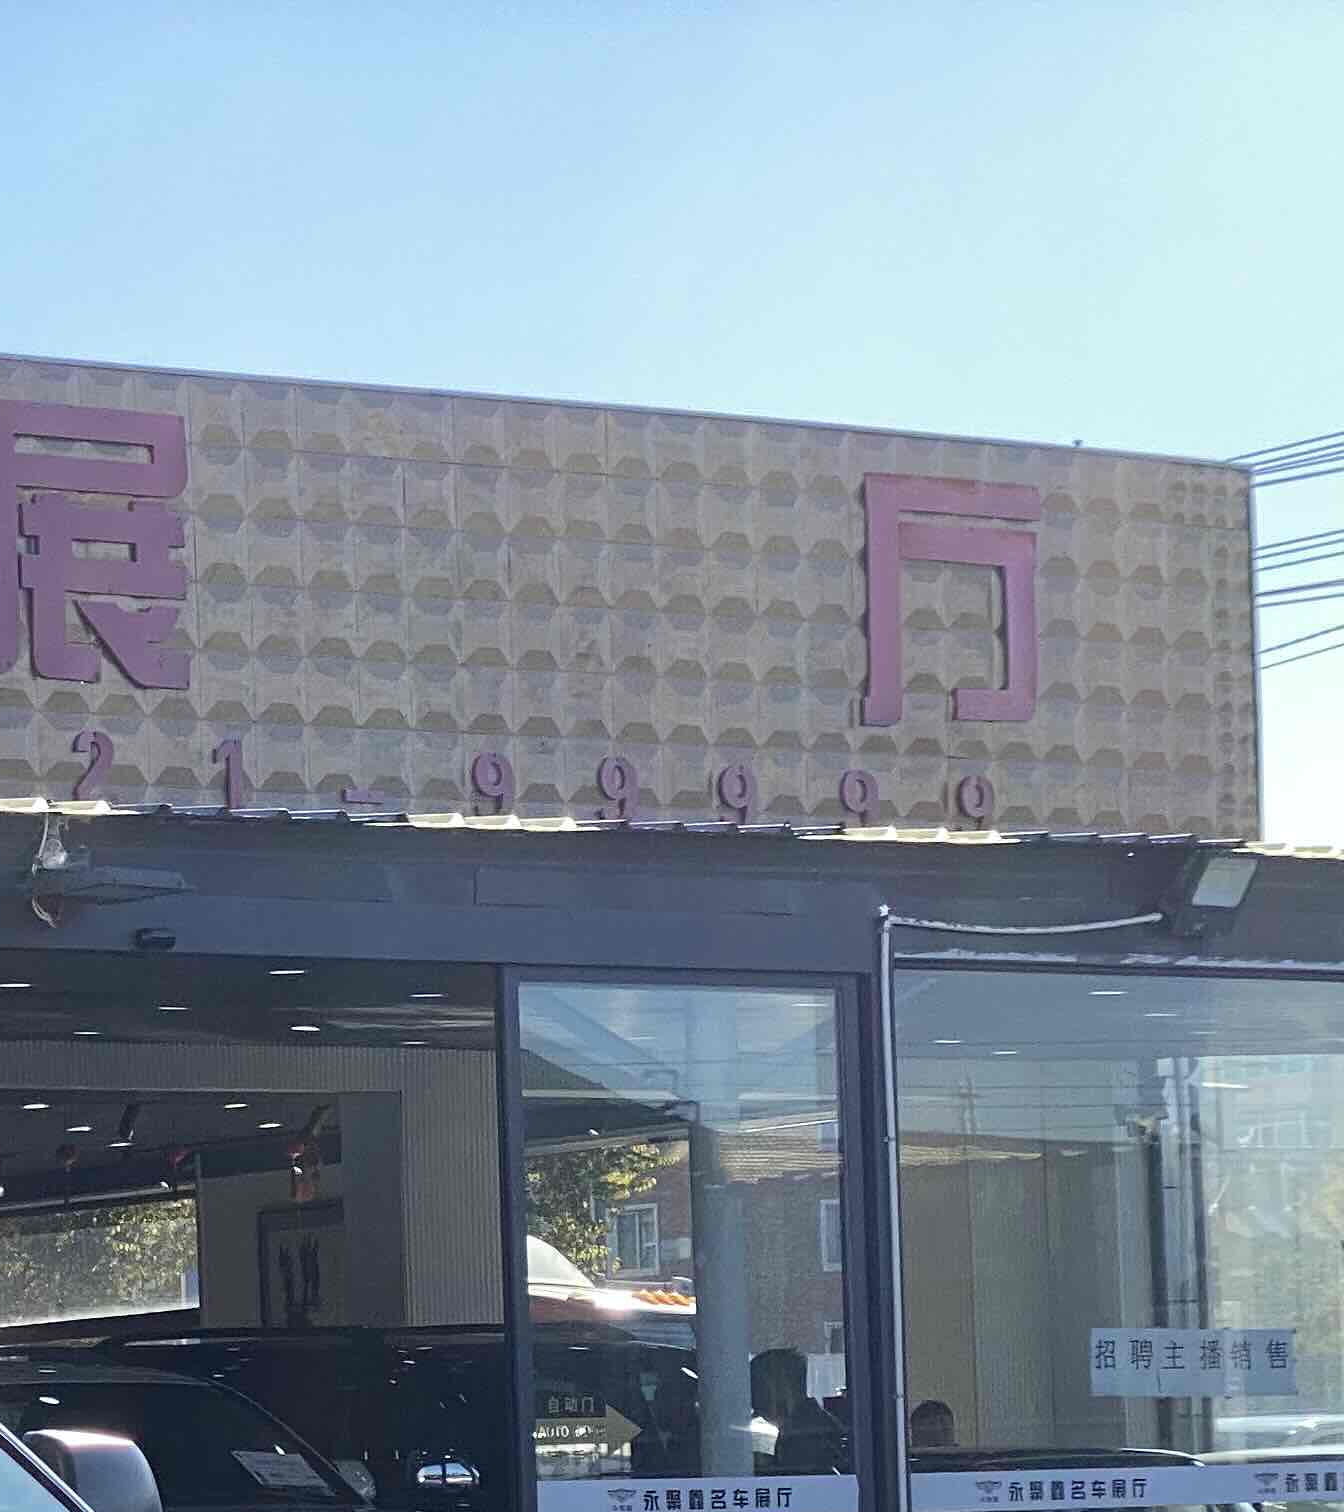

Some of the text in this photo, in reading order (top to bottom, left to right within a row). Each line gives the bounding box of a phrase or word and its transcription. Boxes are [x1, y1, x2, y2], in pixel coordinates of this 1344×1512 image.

[1095, 1338, 1289, 1370] 招聘主播销售
